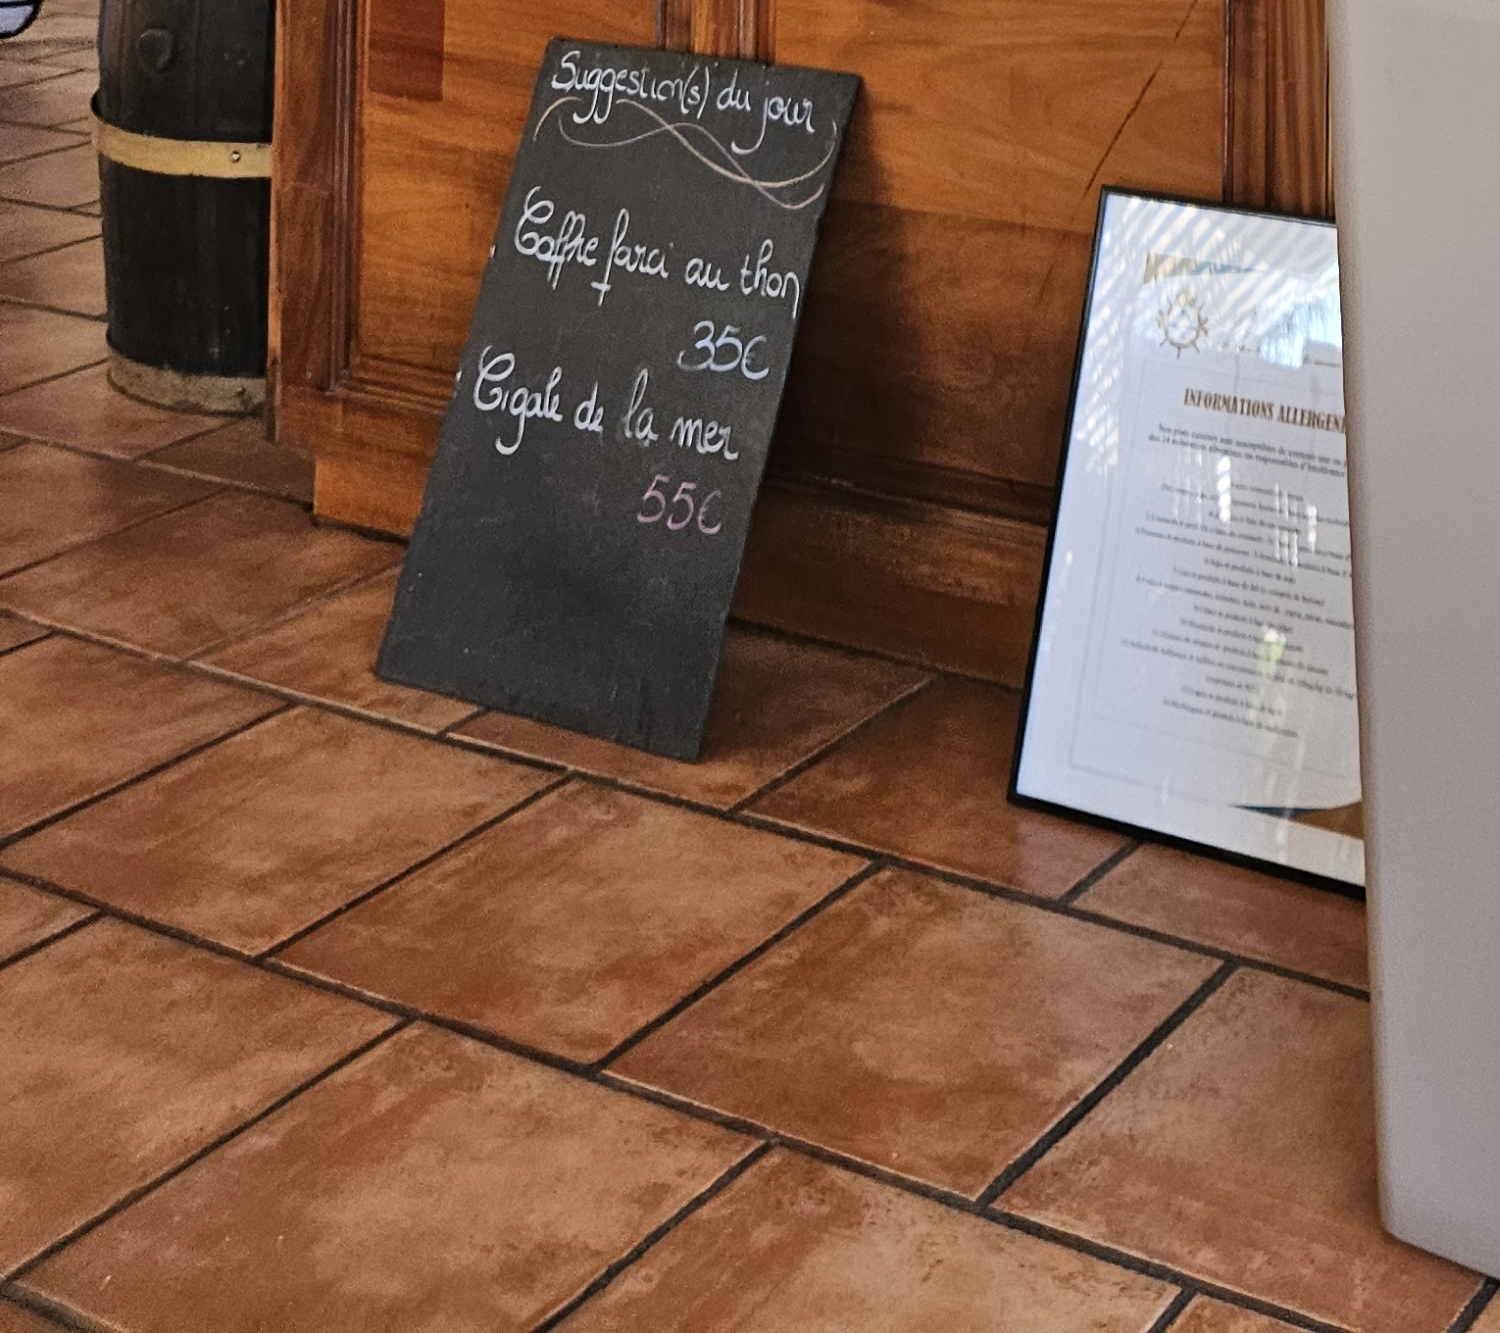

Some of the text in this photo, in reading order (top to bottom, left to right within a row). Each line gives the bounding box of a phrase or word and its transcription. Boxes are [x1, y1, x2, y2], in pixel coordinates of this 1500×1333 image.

[551, 50, 816, 155] Suggestion(s) du jour
[590, 207, 674, 307] farci
[684, 257, 731, 292] au
[740, 238, 801, 320] thon
[676, 319, 770, 381] 35€
[473, 344, 740, 461] Cigale de la mer
[1183, 386, 1275, 421] INFORMATIONS
[636, 473, 723, 535] 55€
